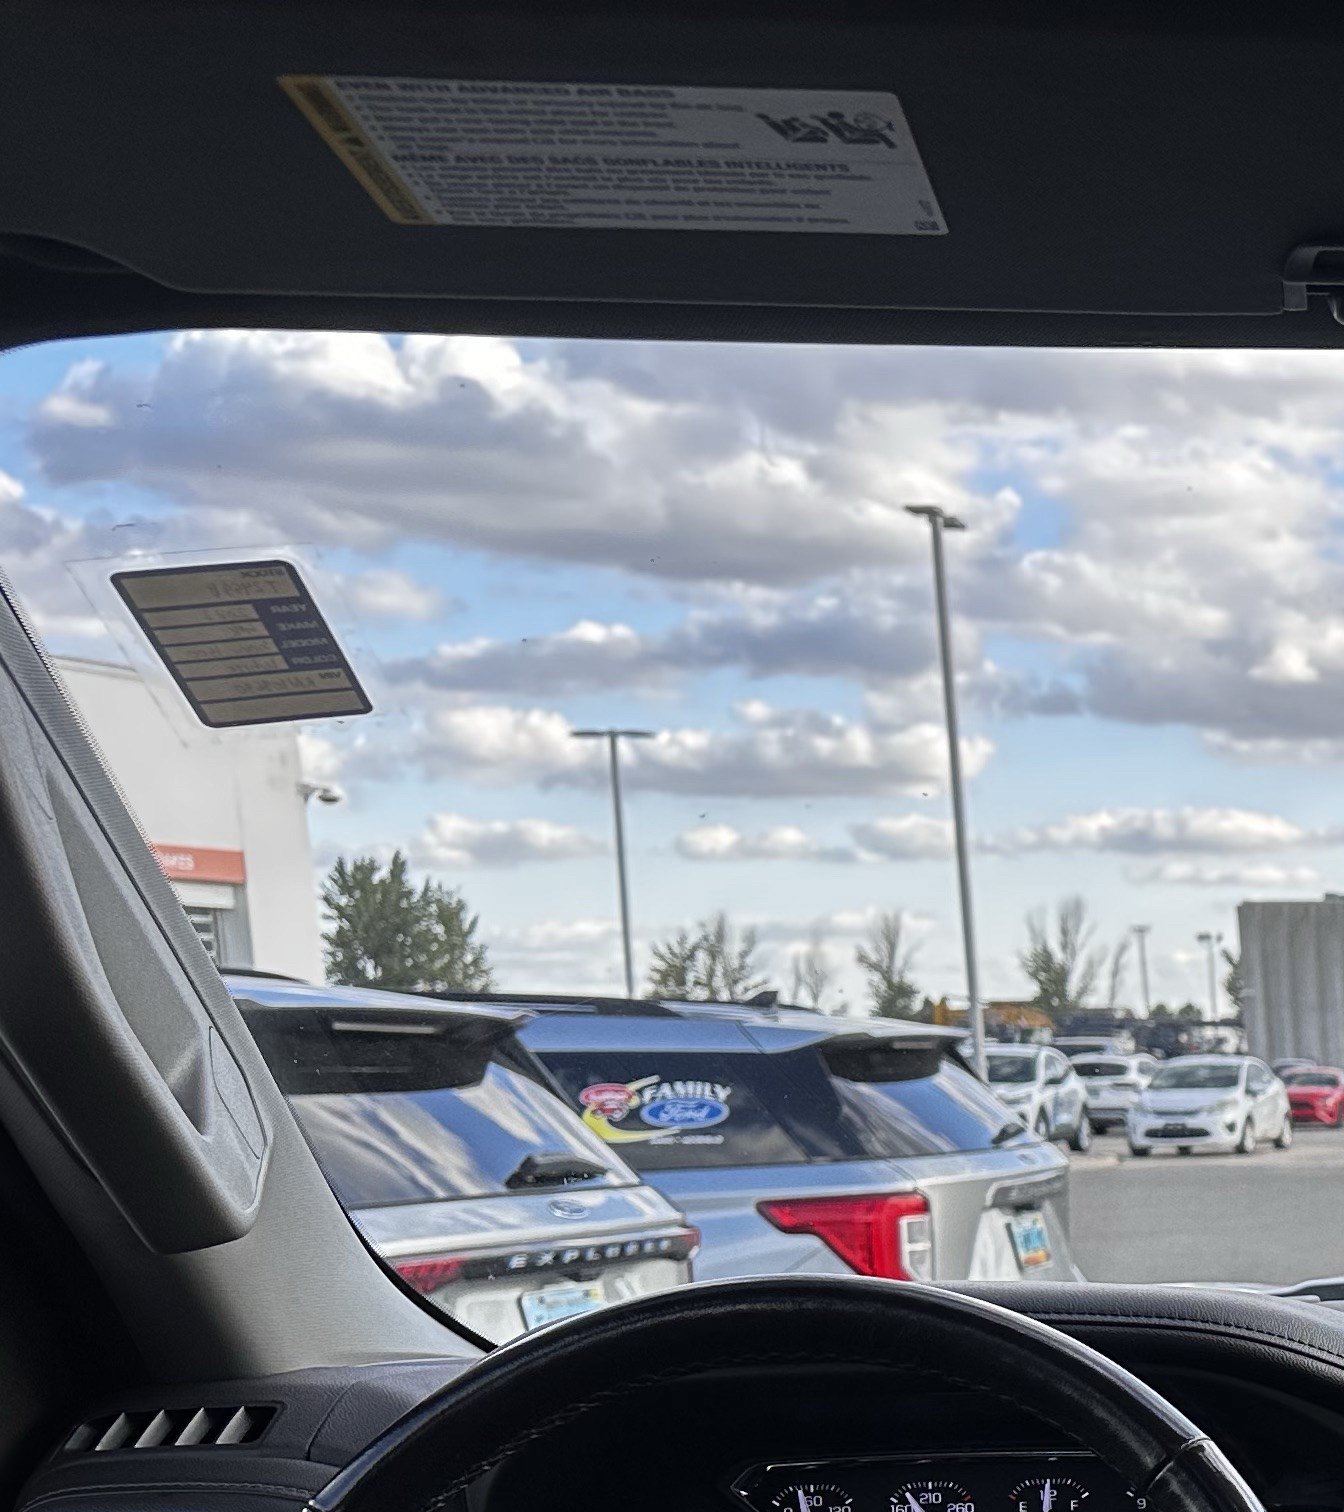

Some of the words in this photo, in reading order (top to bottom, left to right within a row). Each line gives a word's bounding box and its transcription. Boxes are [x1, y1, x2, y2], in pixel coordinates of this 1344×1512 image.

[396, 82, 452, 93] WITH
[642, 1080, 732, 1104] FAMILY
[919, 1492, 942, 1505] 210
[1136, 1497, 1147, 1510] 9
[1019, 1501, 1028, 1512] E
[1070, 1499, 1079, 1511] F
